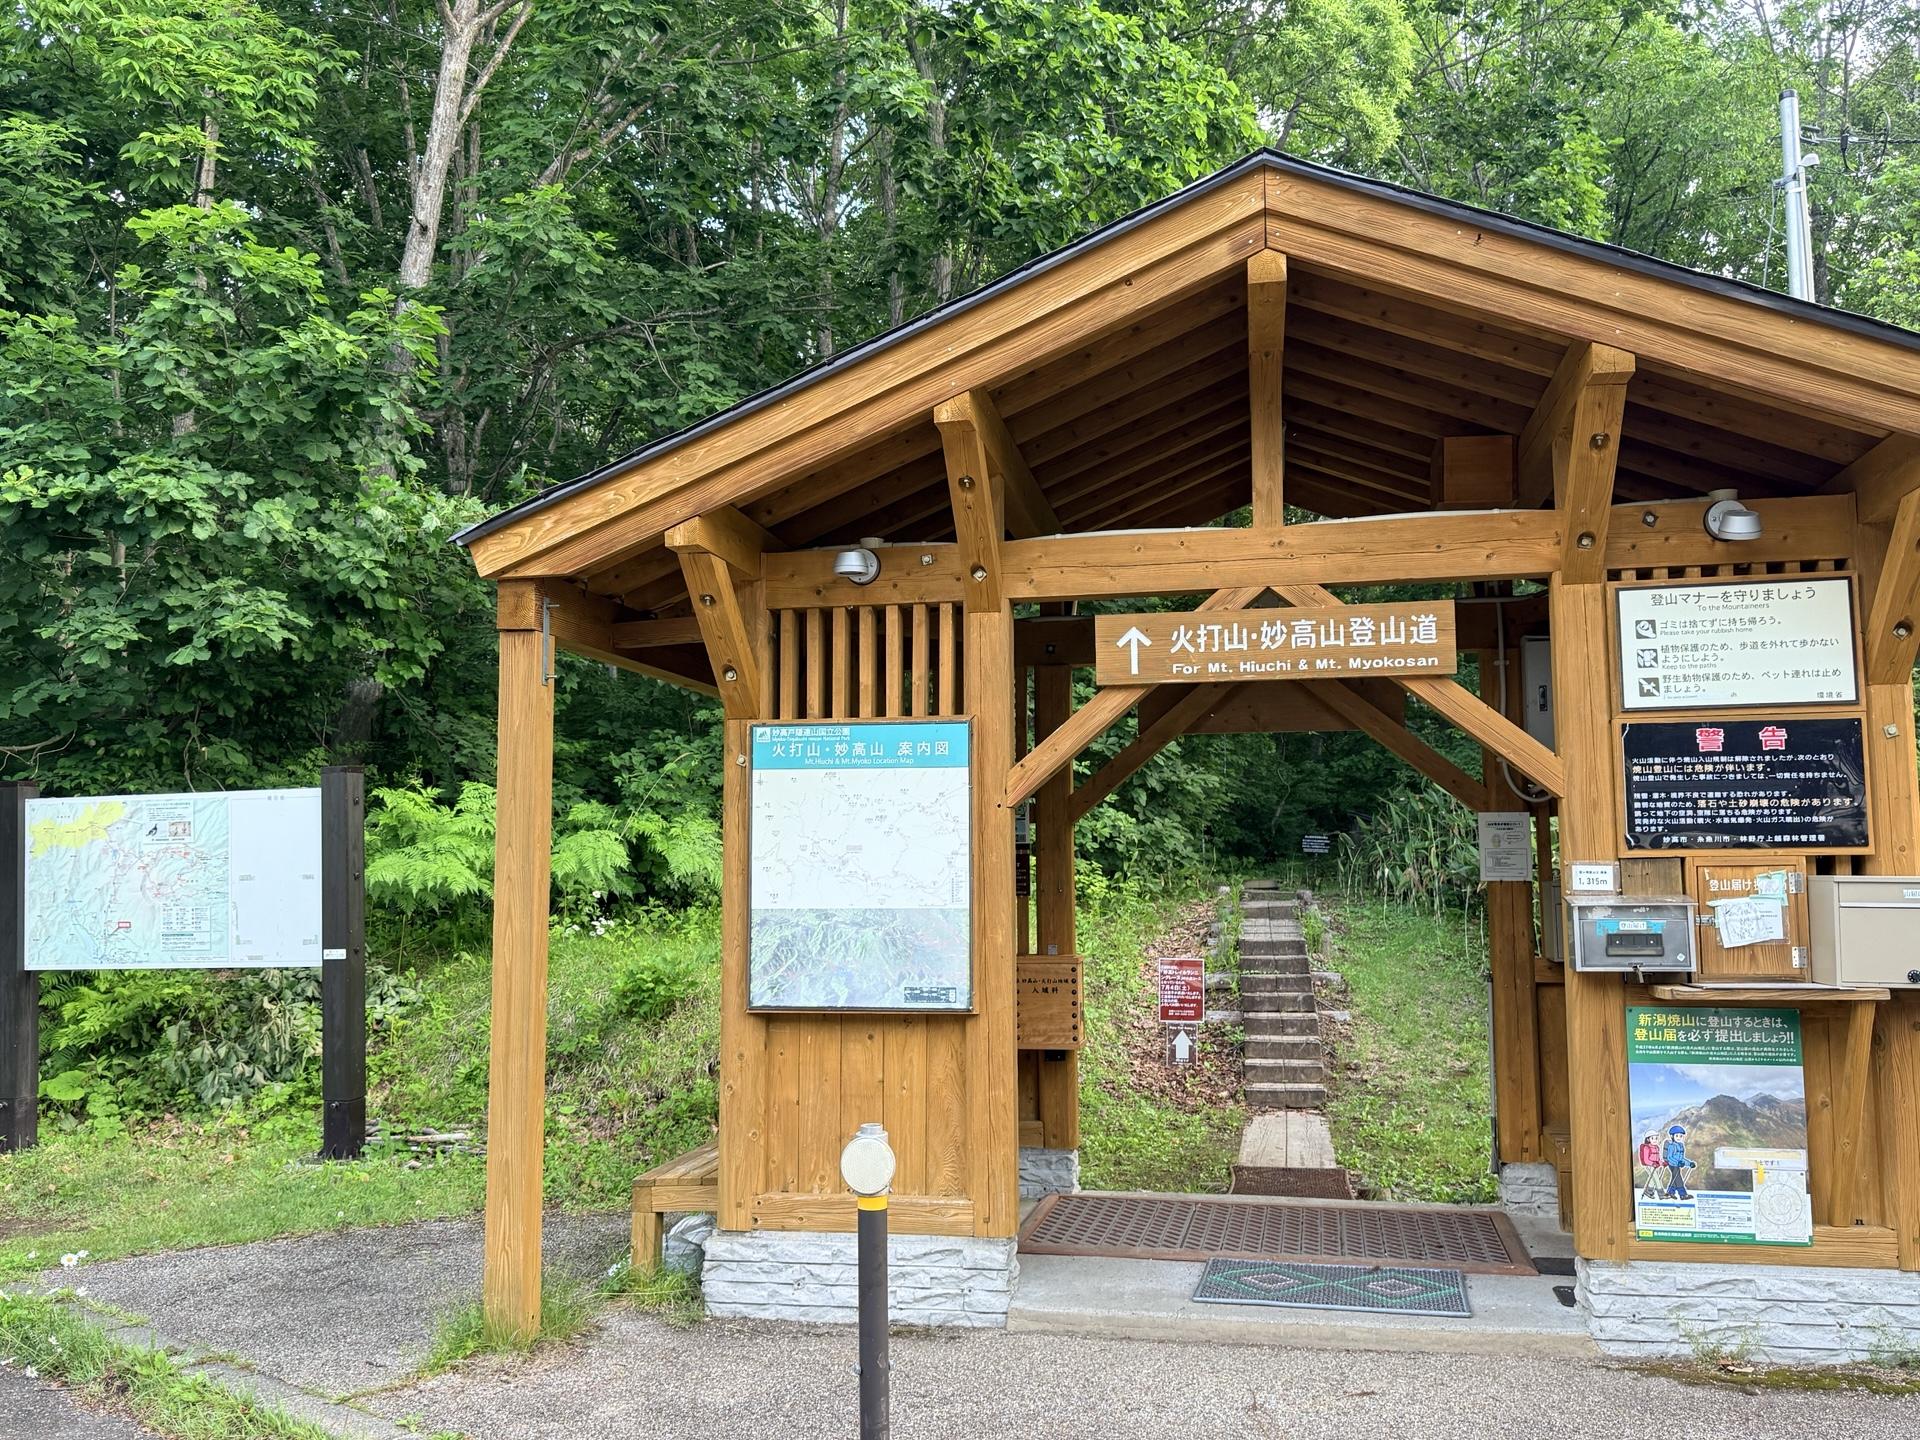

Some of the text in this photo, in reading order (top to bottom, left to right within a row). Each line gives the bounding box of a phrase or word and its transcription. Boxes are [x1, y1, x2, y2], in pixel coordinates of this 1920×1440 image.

[1651, 586, 1816, 606] 登山マナーを守りましょう
[1660, 615, 1781, 629] ゴミは捨てずに持ち帰ろう。
[1170, 613, 1438, 654] 火打山・妙高山登山道
[1172, 656, 1439, 674] For Mt. Hiuchi & Mt. Myokosan
[1662, 653, 1724, 663] ようにしよう。
[1663, 683, 1706, 693] ましょう。
[772, 741, 949, 757] 火打山・妙高山 案内図
[873, 757, 899, 765] Location
[900, 757, 914, 766] Map
[1637, 1013, 1789, 1029] 新潟焼山に登山するときは、
[1633, 1028, 1795, 1044] 登山届を必ず提出しましょう!!
